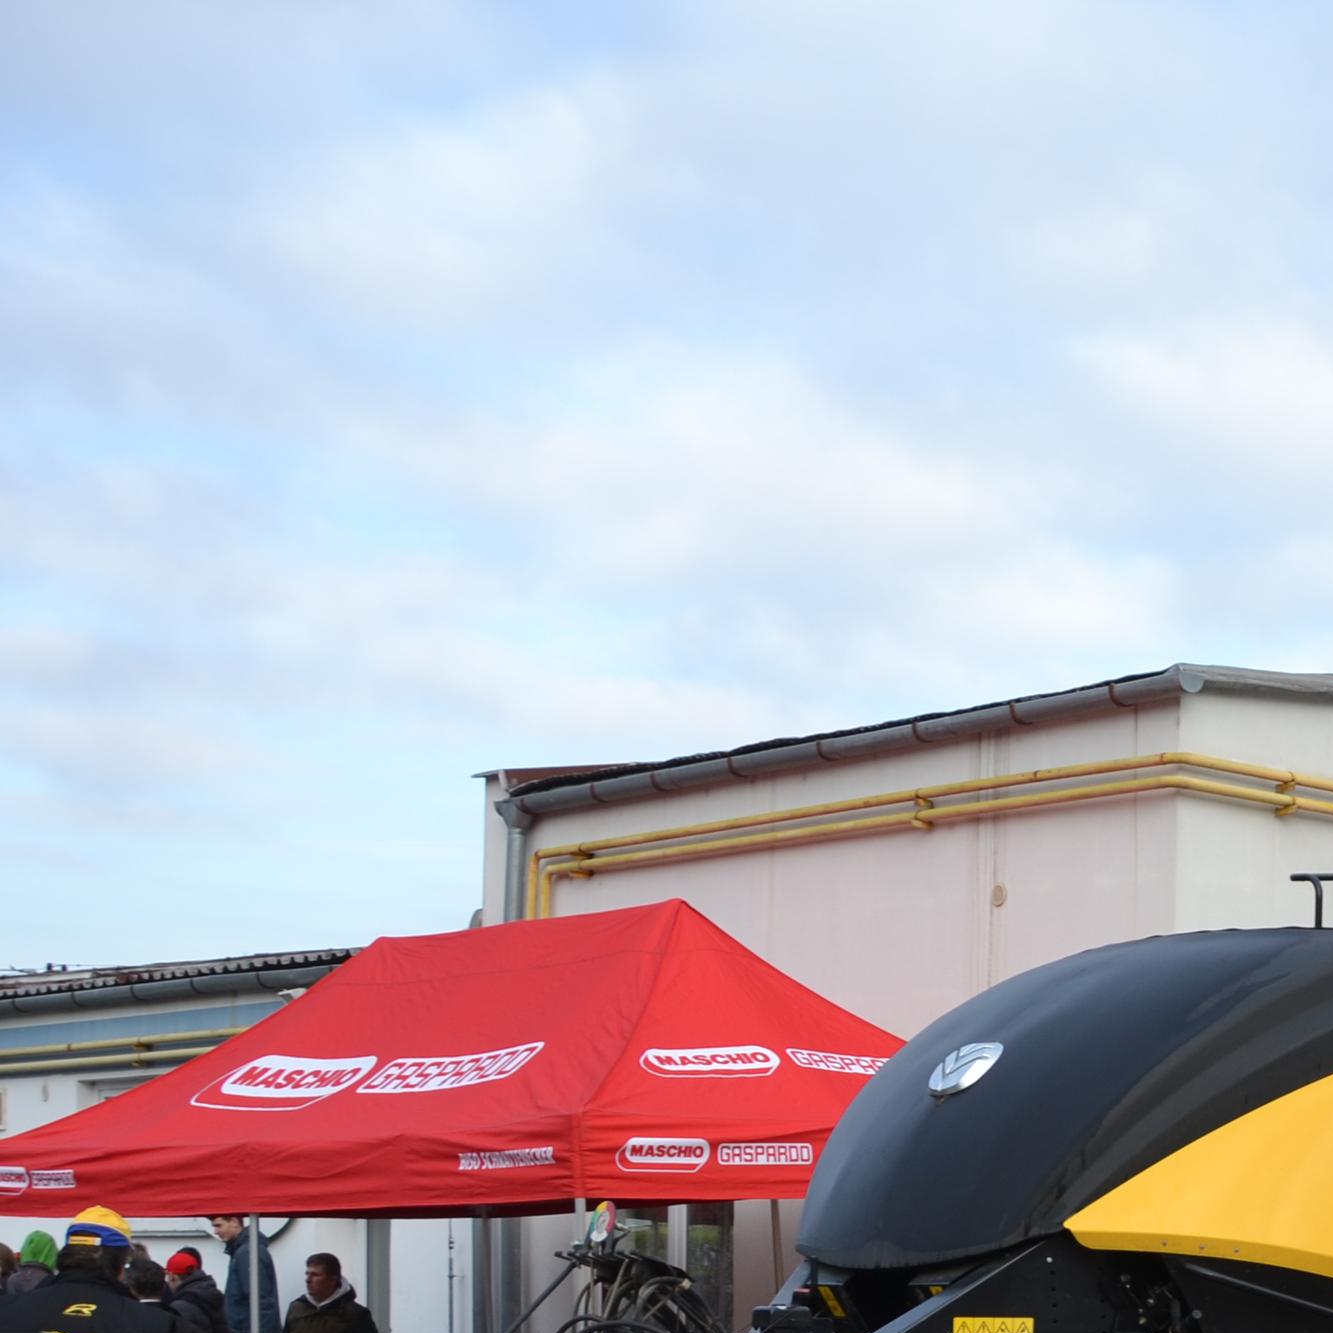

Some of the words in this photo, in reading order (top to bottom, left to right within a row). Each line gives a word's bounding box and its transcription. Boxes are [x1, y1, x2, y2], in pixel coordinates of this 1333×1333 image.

[232, 1065, 364, 1091] MASCHIO
[366, 1045, 540, 1091] GASPARDO
[656, 1051, 771, 1068] MASCHIO
[629, 1143, 704, 1158] MASCHIO
[719, 1145, 811, 1162] GASPARDO
